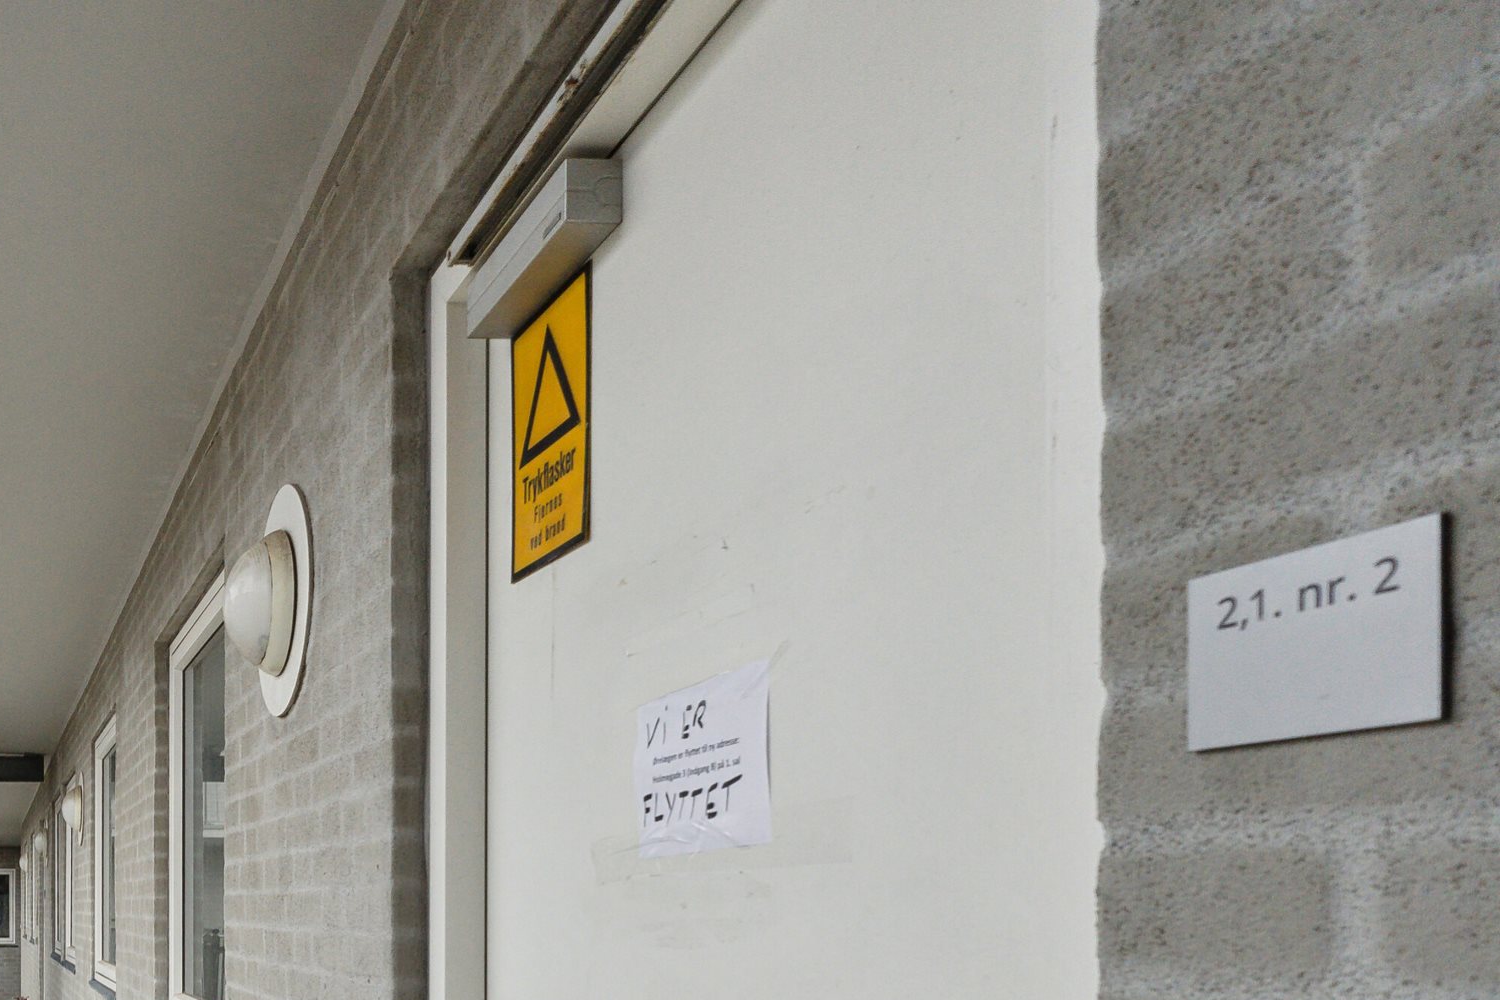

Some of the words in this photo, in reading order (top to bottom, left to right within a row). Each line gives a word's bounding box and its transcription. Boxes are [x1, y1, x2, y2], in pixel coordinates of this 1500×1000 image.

[522, 447, 576, 504] Trykflasker
[534, 493, 563, 523] Fjernes
[530, 530, 542, 550] ved
[545, 513, 566, 542] brand
[1217, 588, 1282, 630] 2,1.
[1297, 575, 1357, 612] nr.
[1372, 556, 1401, 595] 2
[682, 700, 706, 739] ER
[643, 774, 743, 828] FLYTTET
